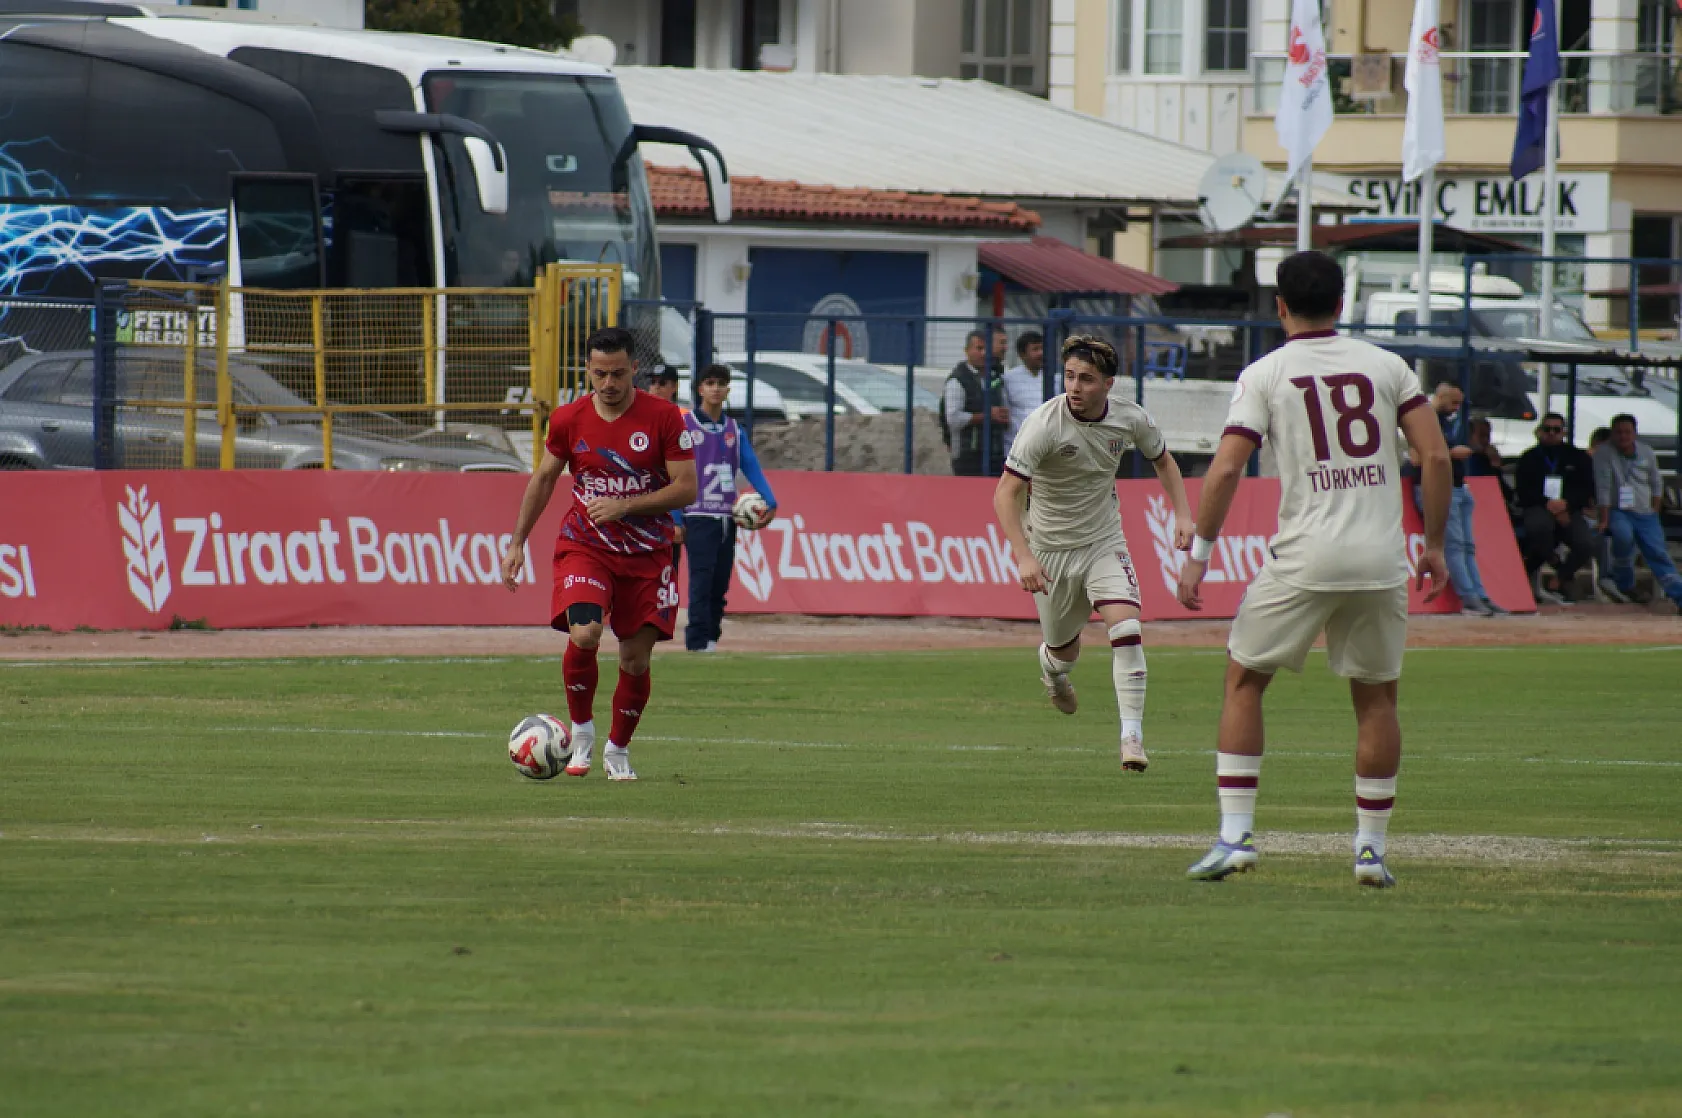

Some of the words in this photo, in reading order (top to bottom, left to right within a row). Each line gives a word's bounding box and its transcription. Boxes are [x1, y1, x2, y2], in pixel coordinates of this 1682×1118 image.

[134, 310, 217, 332] FETHYE
[1288, 372, 1381, 462] 18
[583, 474, 651, 494] ESNAF
[1306, 463, 1386, 492] TÜRKMEN
[173, 512, 346, 585] Ziraat
[768, 513, 913, 582] Ziraat
[906, 521, 1021, 584] Bank
